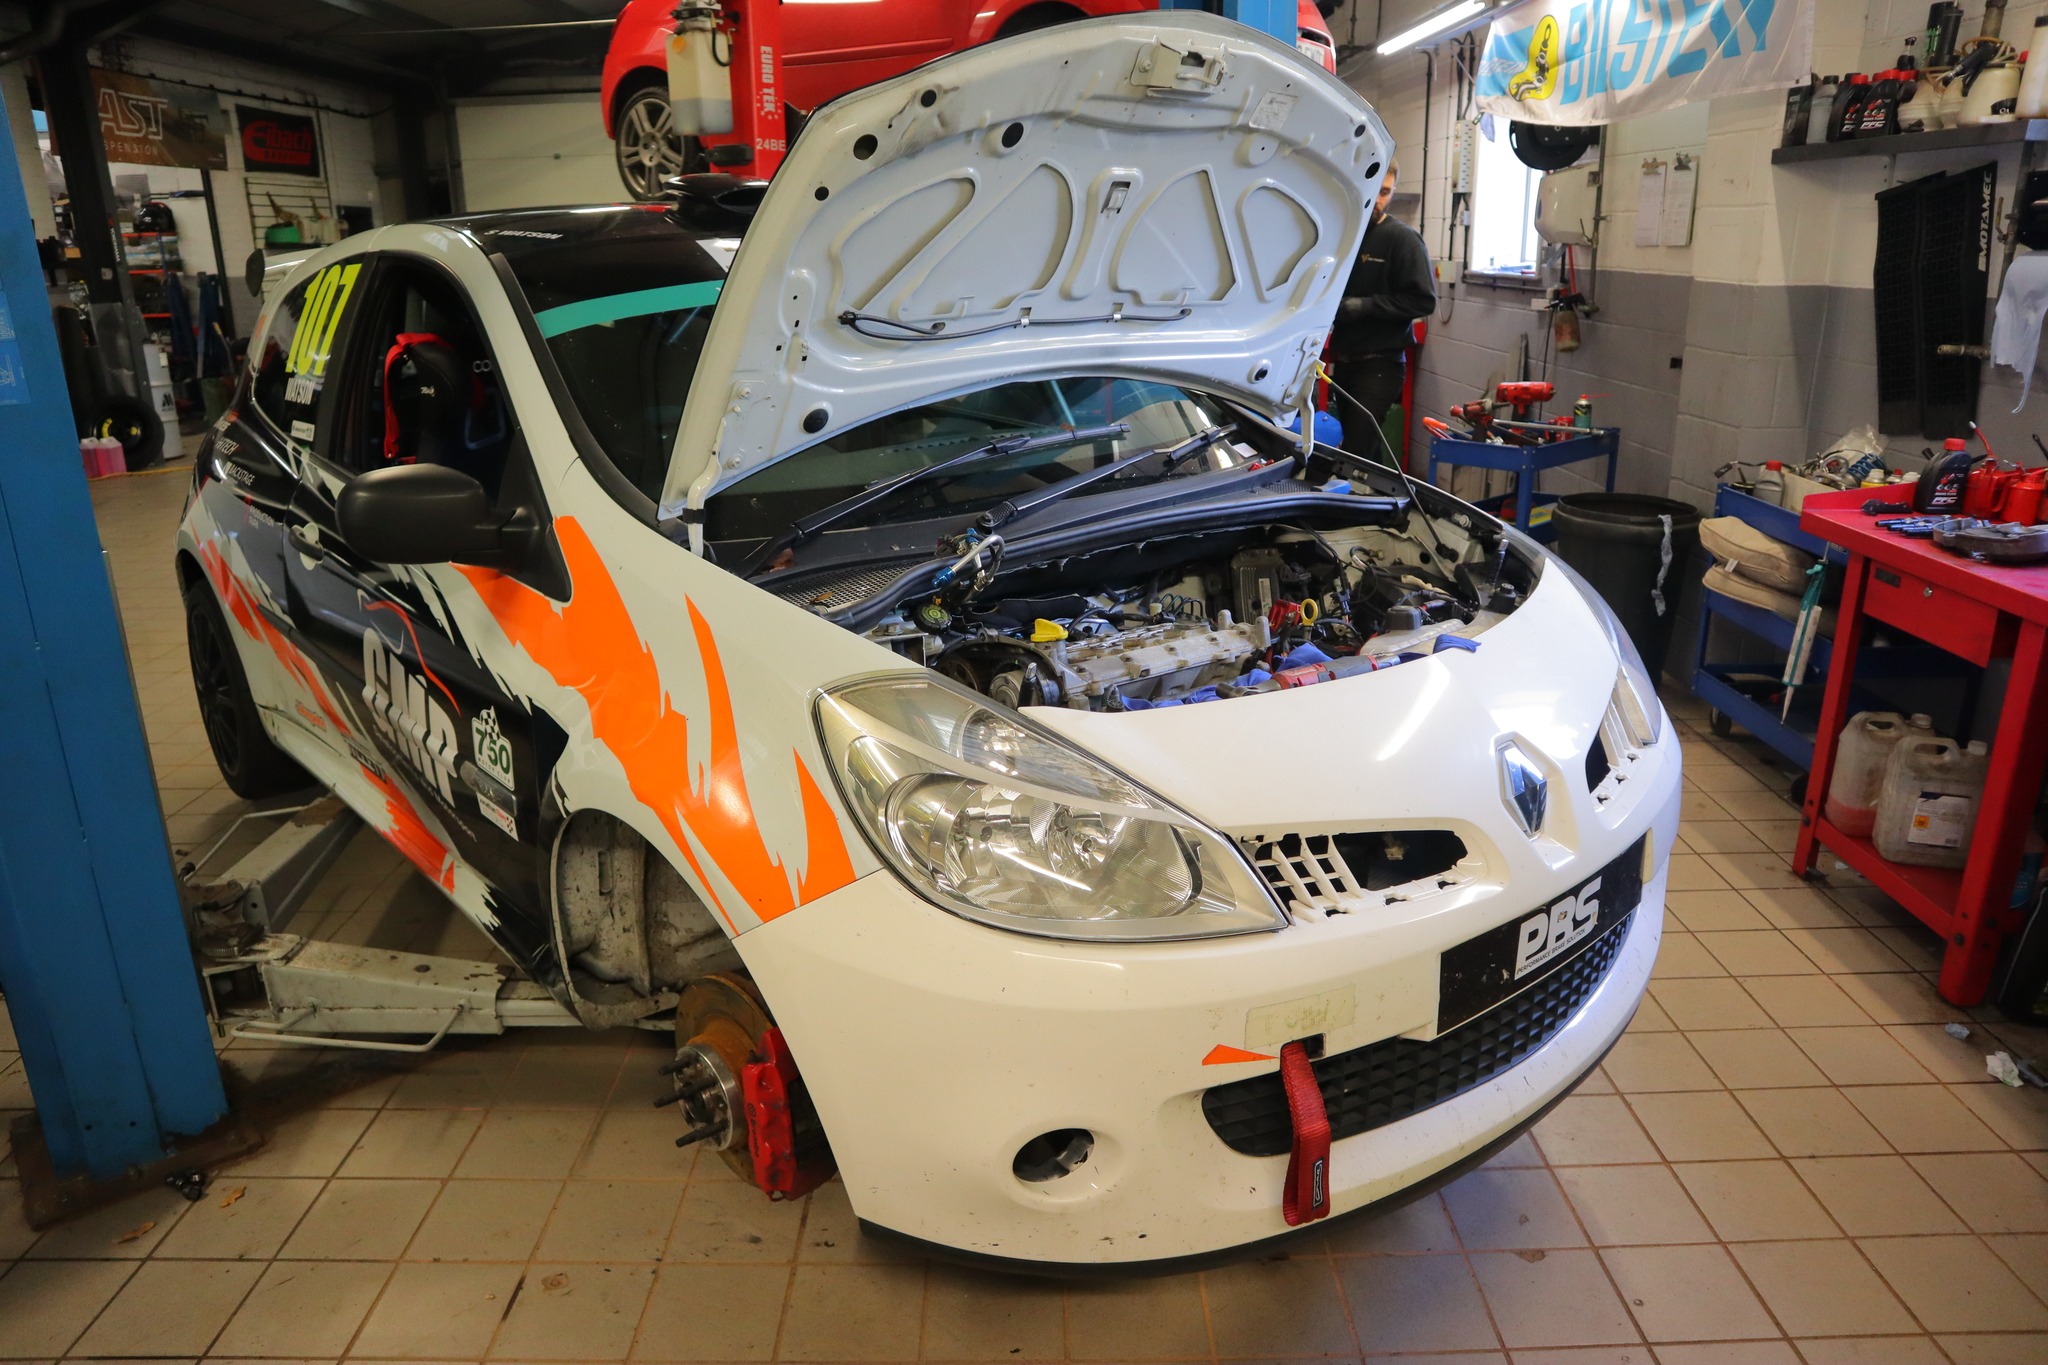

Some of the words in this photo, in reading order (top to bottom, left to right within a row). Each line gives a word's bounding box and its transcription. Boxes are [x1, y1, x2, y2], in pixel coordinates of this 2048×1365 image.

[760, 46, 774, 84] EURO
[498, 230, 564, 240] WATSON
[1979, 169, 1992, 257] MOTAMEC
[285, 263, 362, 376] 107
[285, 377, 316, 406] WATSON
[475, 726, 511, 776] 750
[1515, 876, 1602, 980] PBS
[1516, 952, 1551, 975] PERFORMANCE
[1551, 942, 1566, 954] BRAKE
